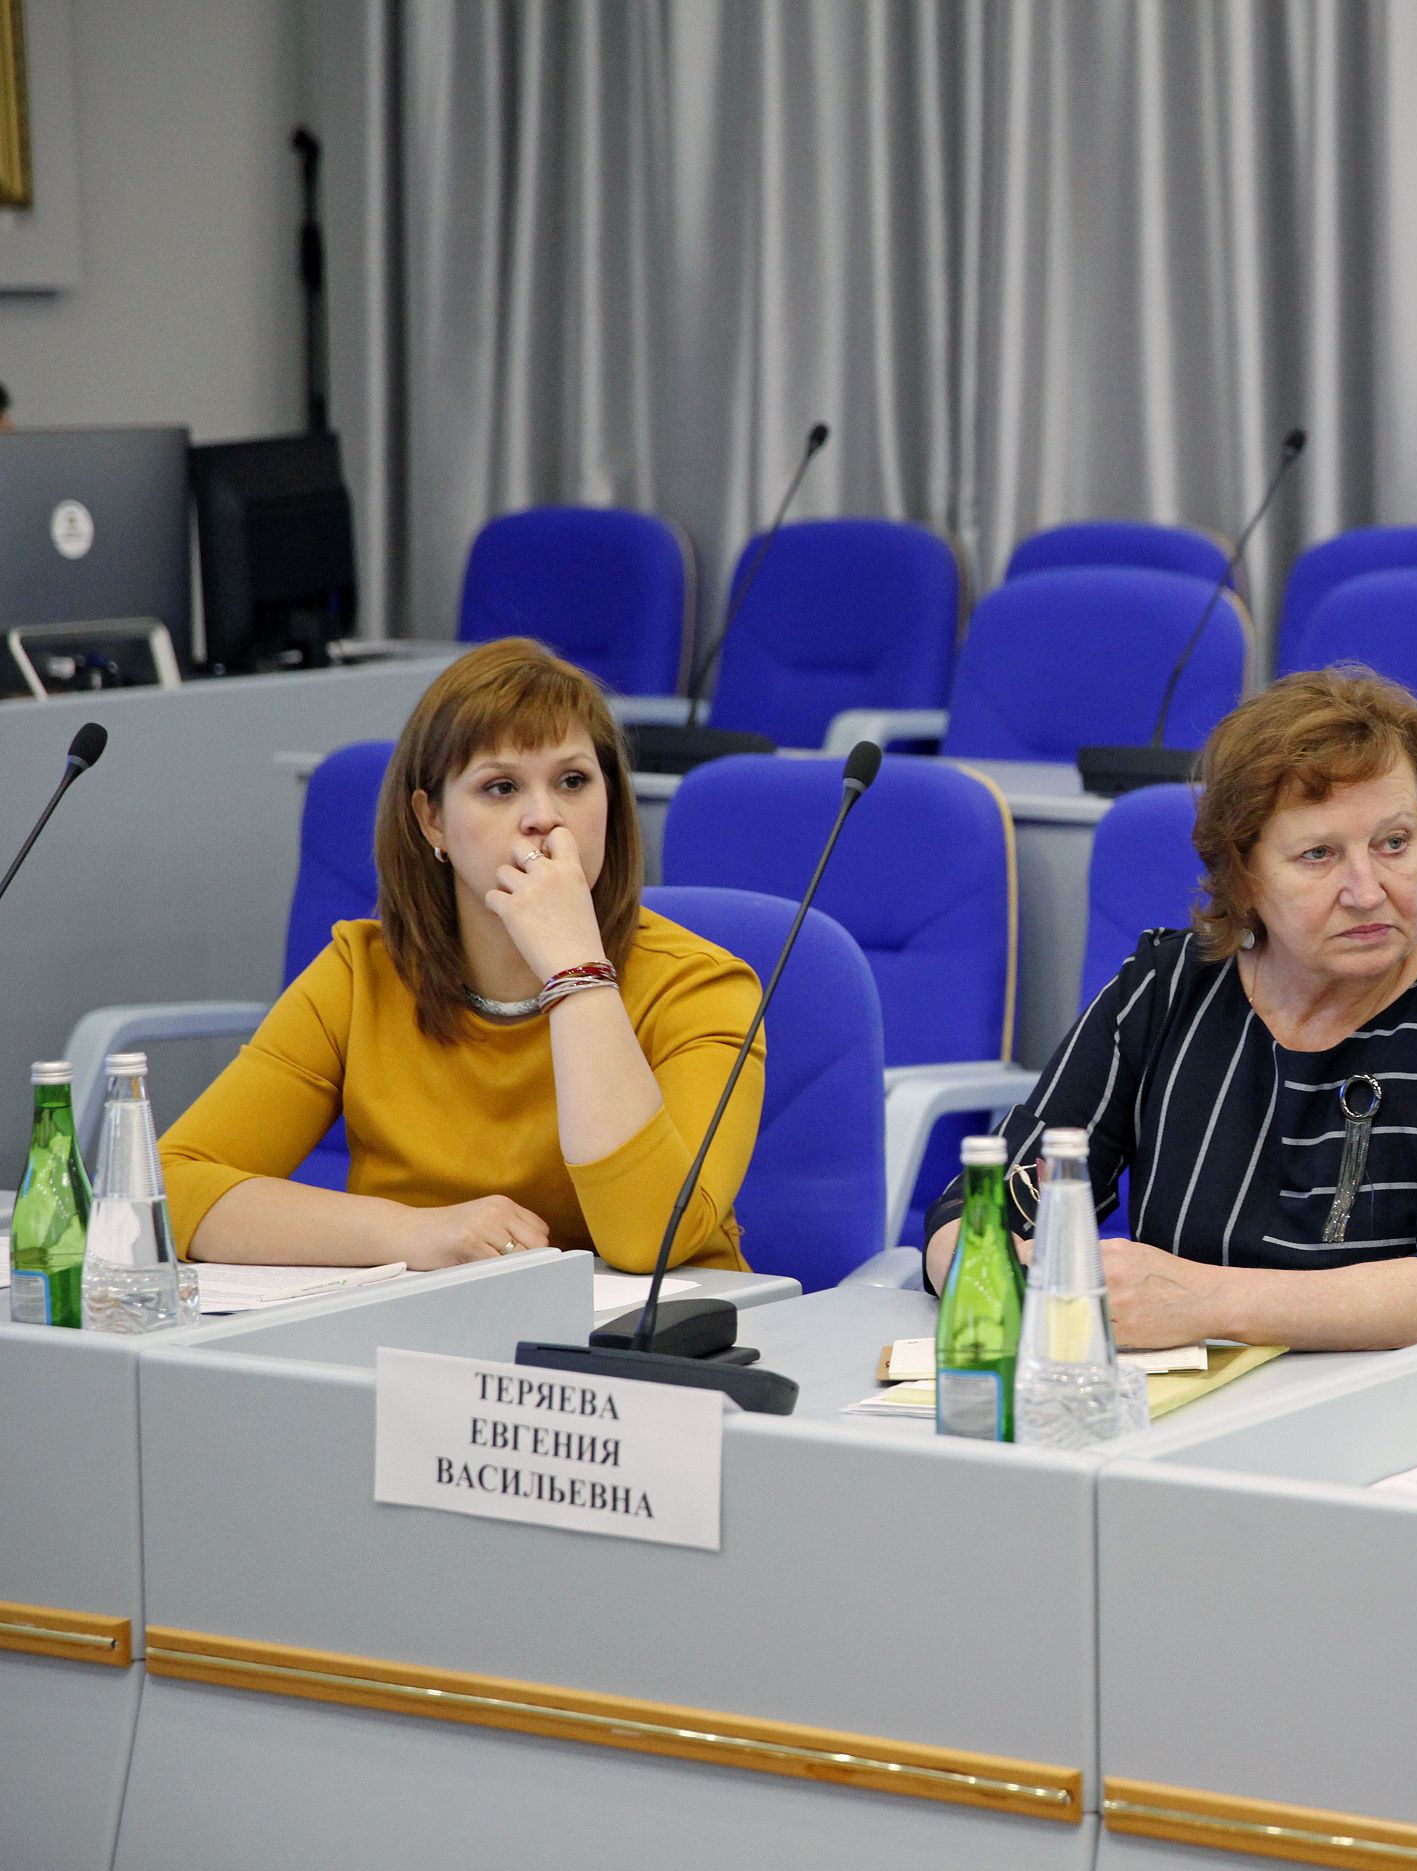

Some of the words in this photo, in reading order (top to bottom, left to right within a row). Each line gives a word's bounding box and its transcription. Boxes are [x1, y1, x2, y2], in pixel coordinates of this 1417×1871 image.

[475, 1372, 620, 1420] ТЕРЯЕВА
[470, 1417, 621, 1467] ЕВГЕНИЯ
[435, 1455, 654, 1518] ВАСИЛЬЕВНА
